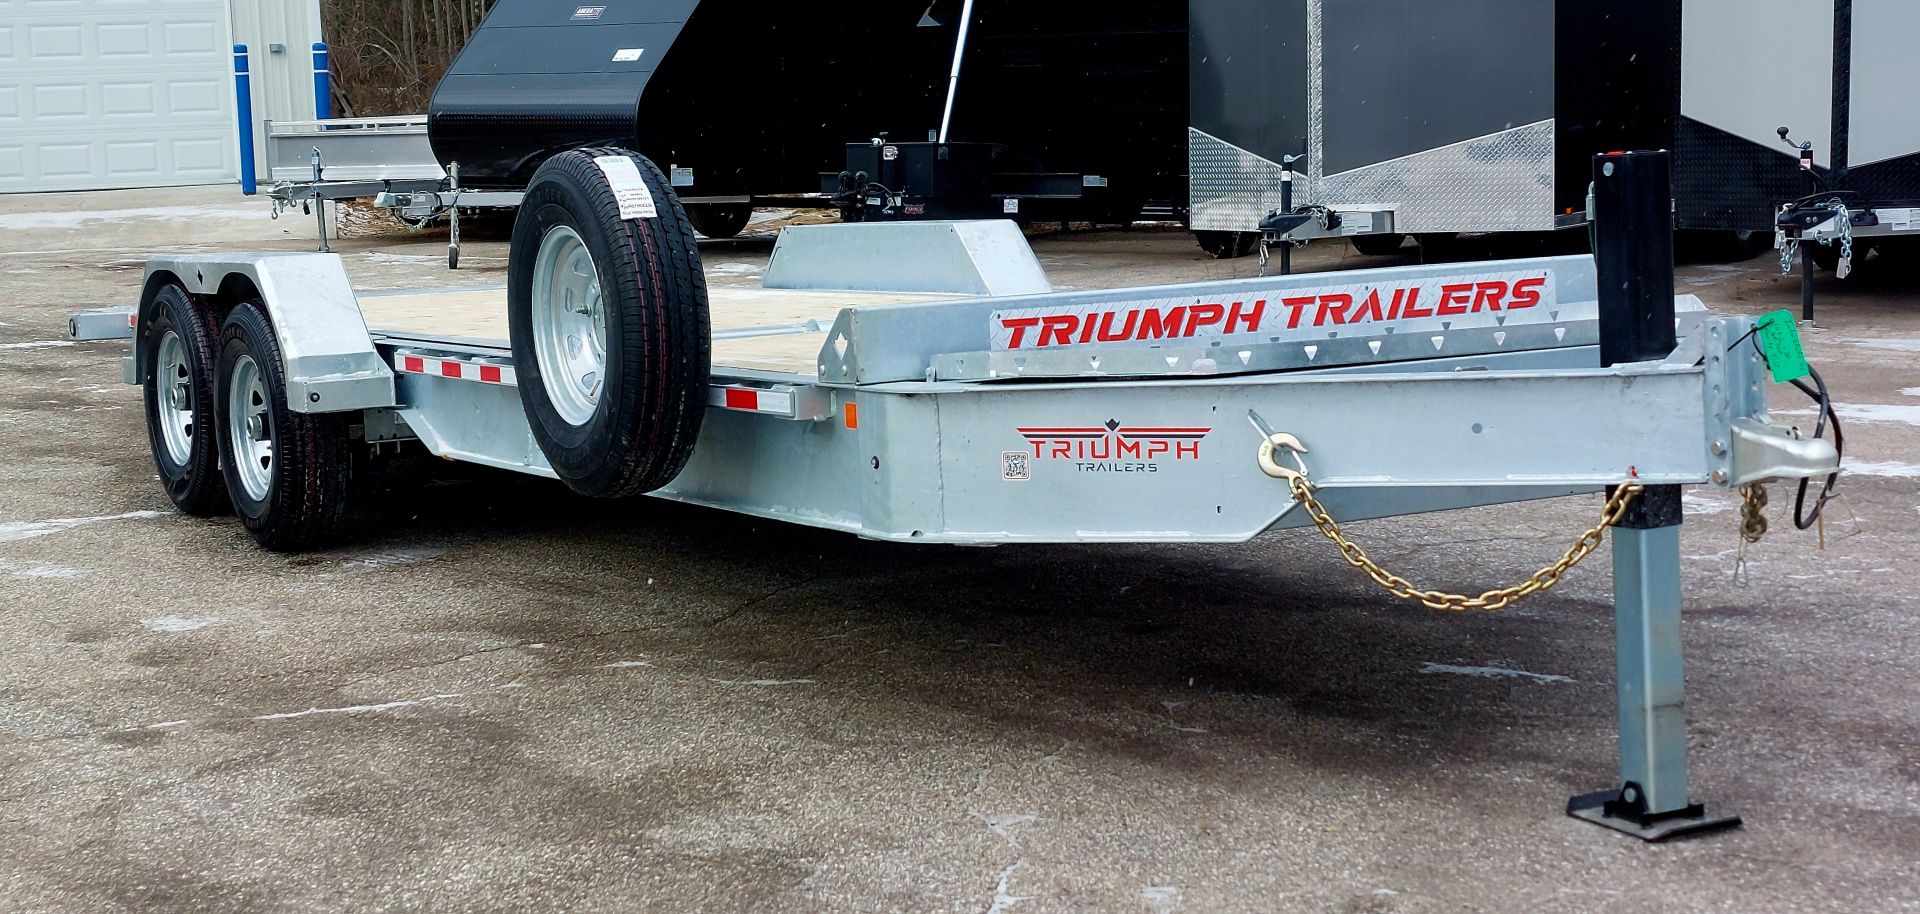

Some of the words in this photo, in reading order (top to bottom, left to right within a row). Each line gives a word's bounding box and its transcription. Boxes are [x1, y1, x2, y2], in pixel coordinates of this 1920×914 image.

[1001, 300, 1266, 349] TRIUMPH
[1282, 277, 1546, 329] TRAILERS
[1028, 434, 1200, 459] TRIUMPH
[1075, 462, 1158, 472] TRAILERS
